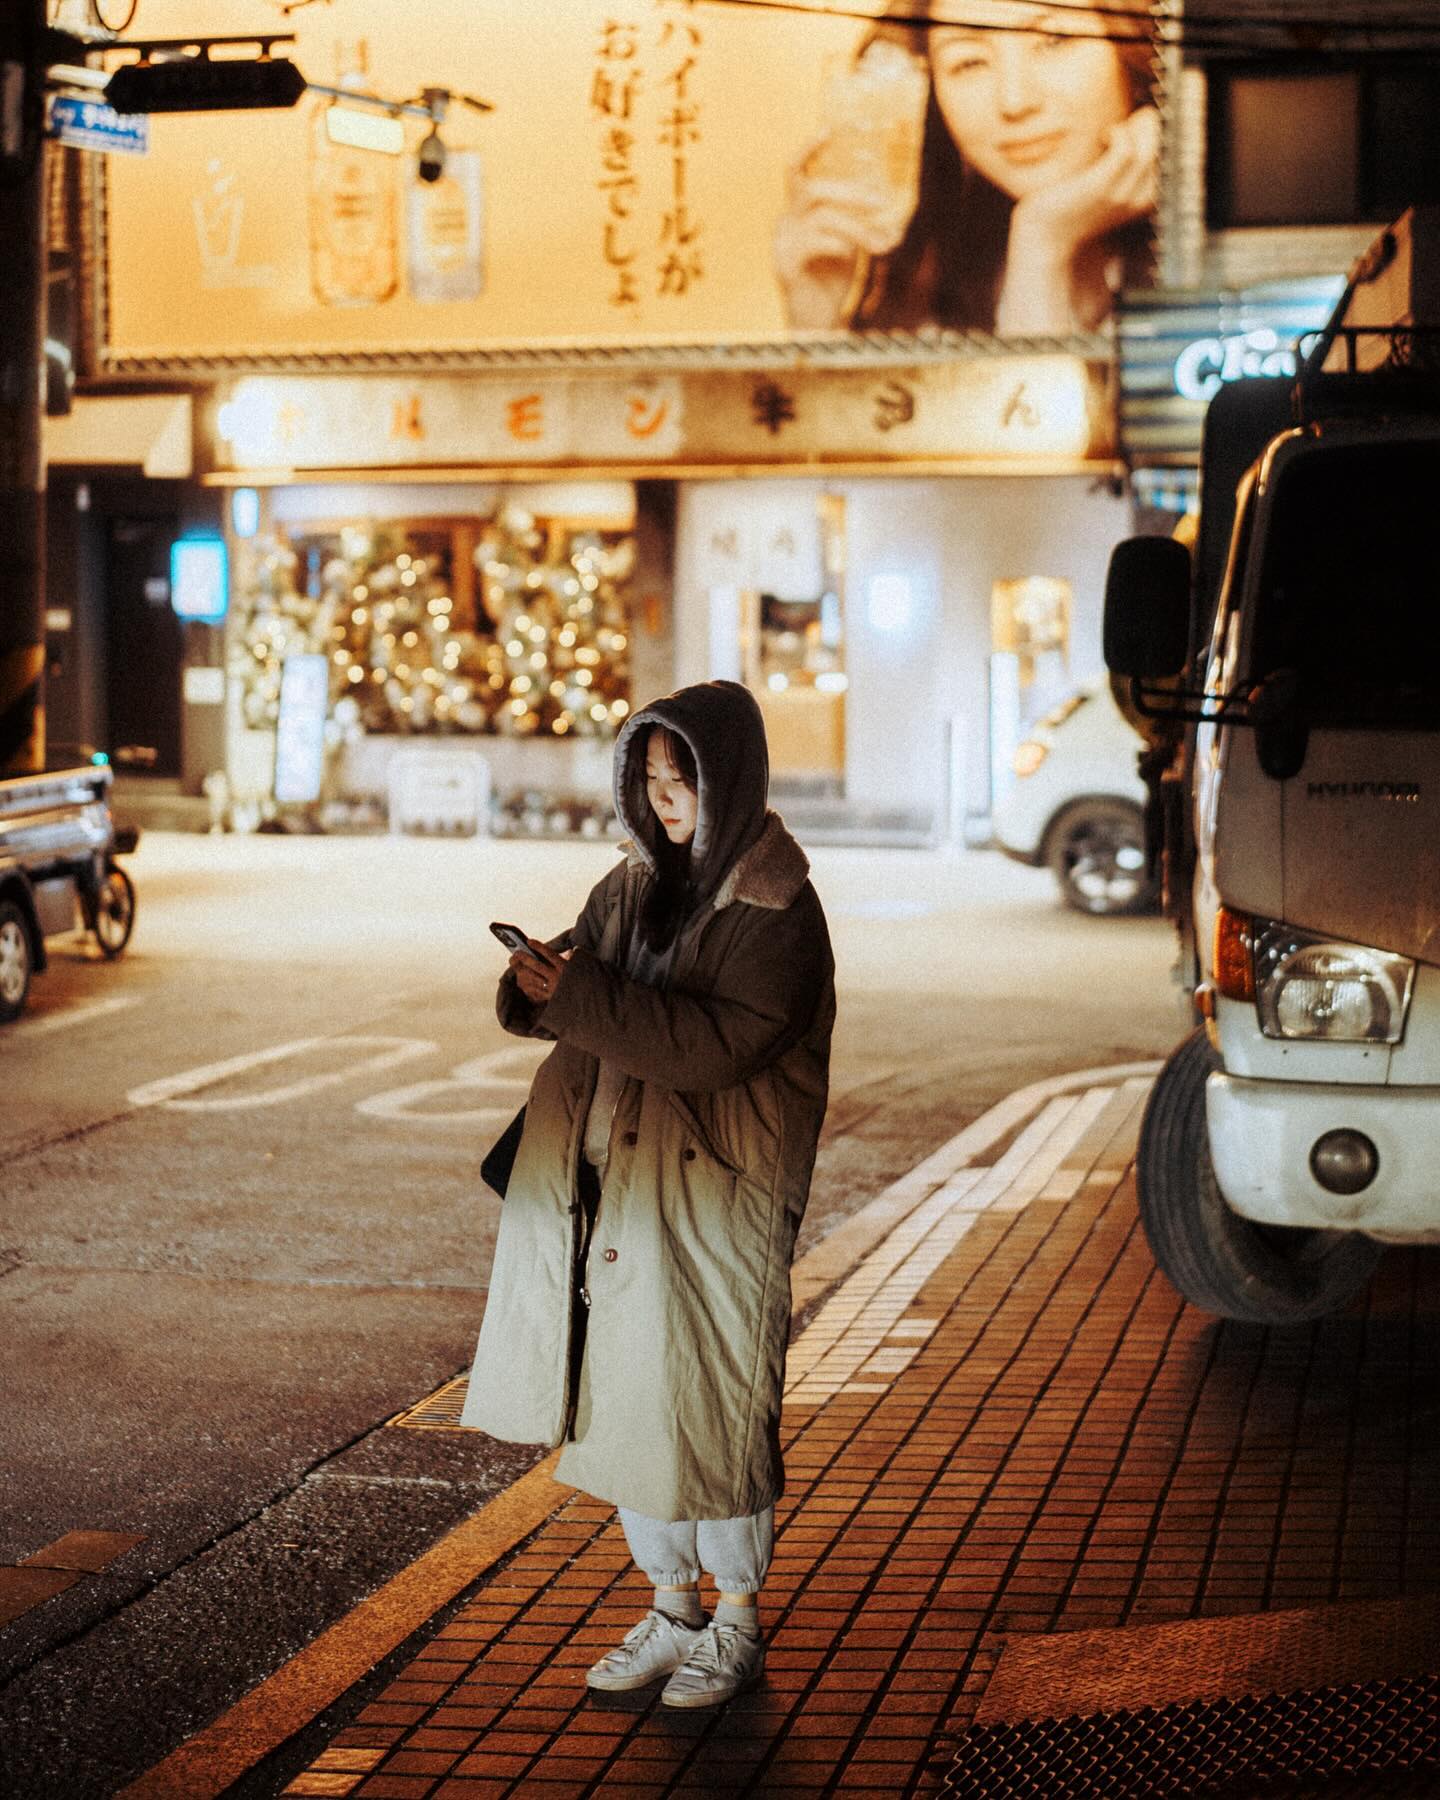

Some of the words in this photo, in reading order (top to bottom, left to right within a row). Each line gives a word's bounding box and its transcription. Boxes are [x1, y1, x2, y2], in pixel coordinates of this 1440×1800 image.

[657, 0, 704, 295] ハイボールが
[1307, 782, 1421, 801] HYUNDAI
